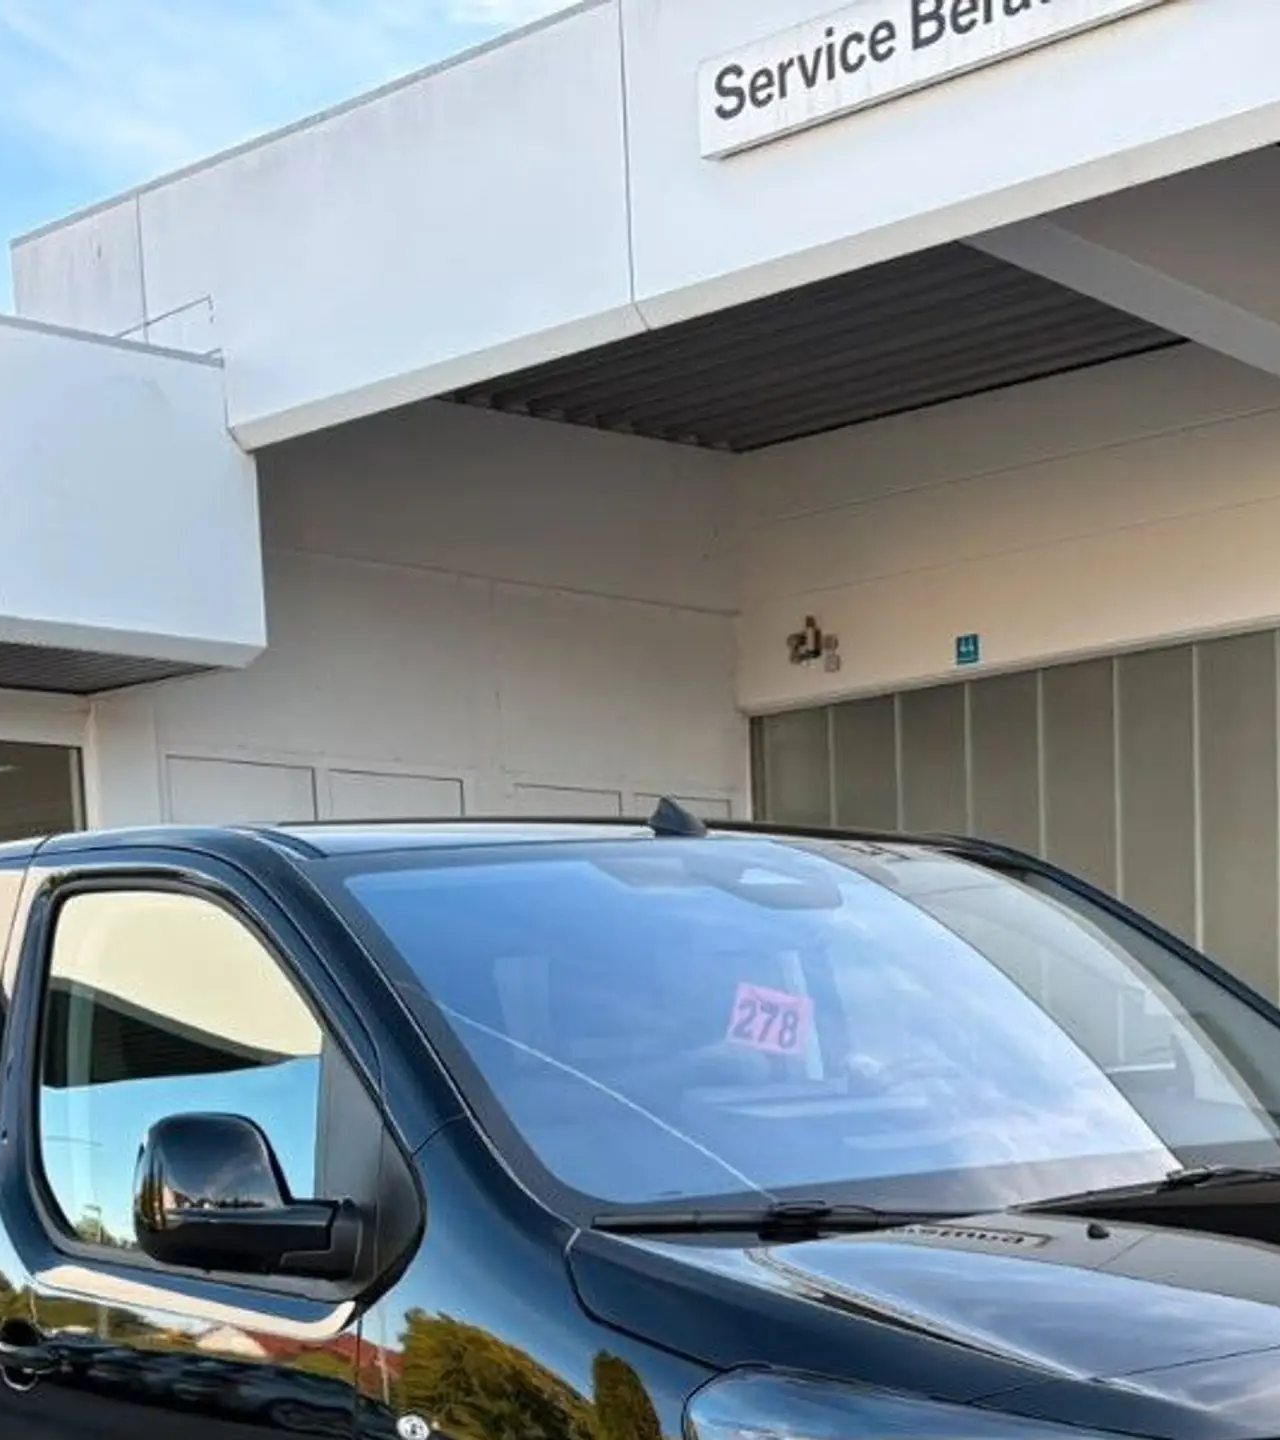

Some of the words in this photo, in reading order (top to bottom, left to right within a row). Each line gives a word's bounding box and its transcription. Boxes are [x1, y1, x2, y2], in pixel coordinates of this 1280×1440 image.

[714, 18, 897, 120] Service
[911, 0, 1051, 50] Ber
[732, 998, 799, 1050] 278
